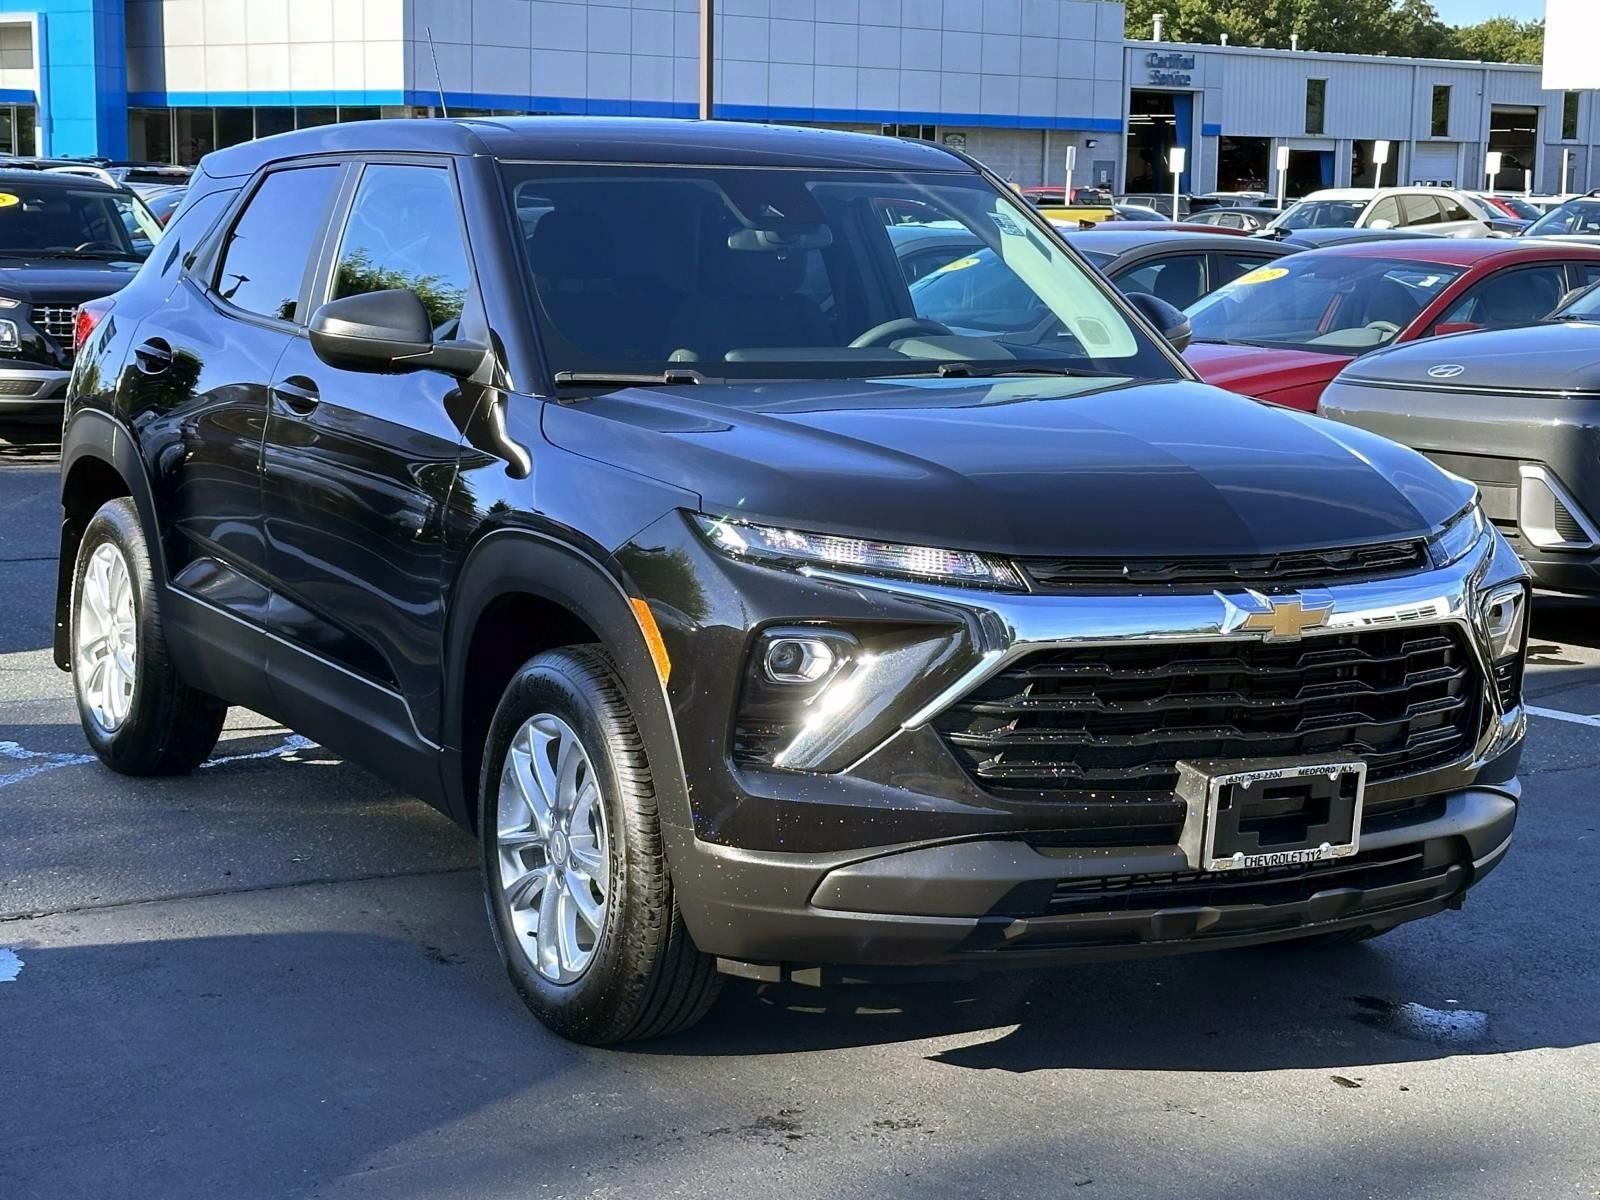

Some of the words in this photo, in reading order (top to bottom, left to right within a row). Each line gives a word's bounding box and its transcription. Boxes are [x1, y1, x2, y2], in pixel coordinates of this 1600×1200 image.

[1146, 53, 1195, 69] Certified
[1149, 70, 1191, 86] Service
[1244, 851, 1304, 868] CHEVROLET
[1306, 849, 1322, 862] 112
